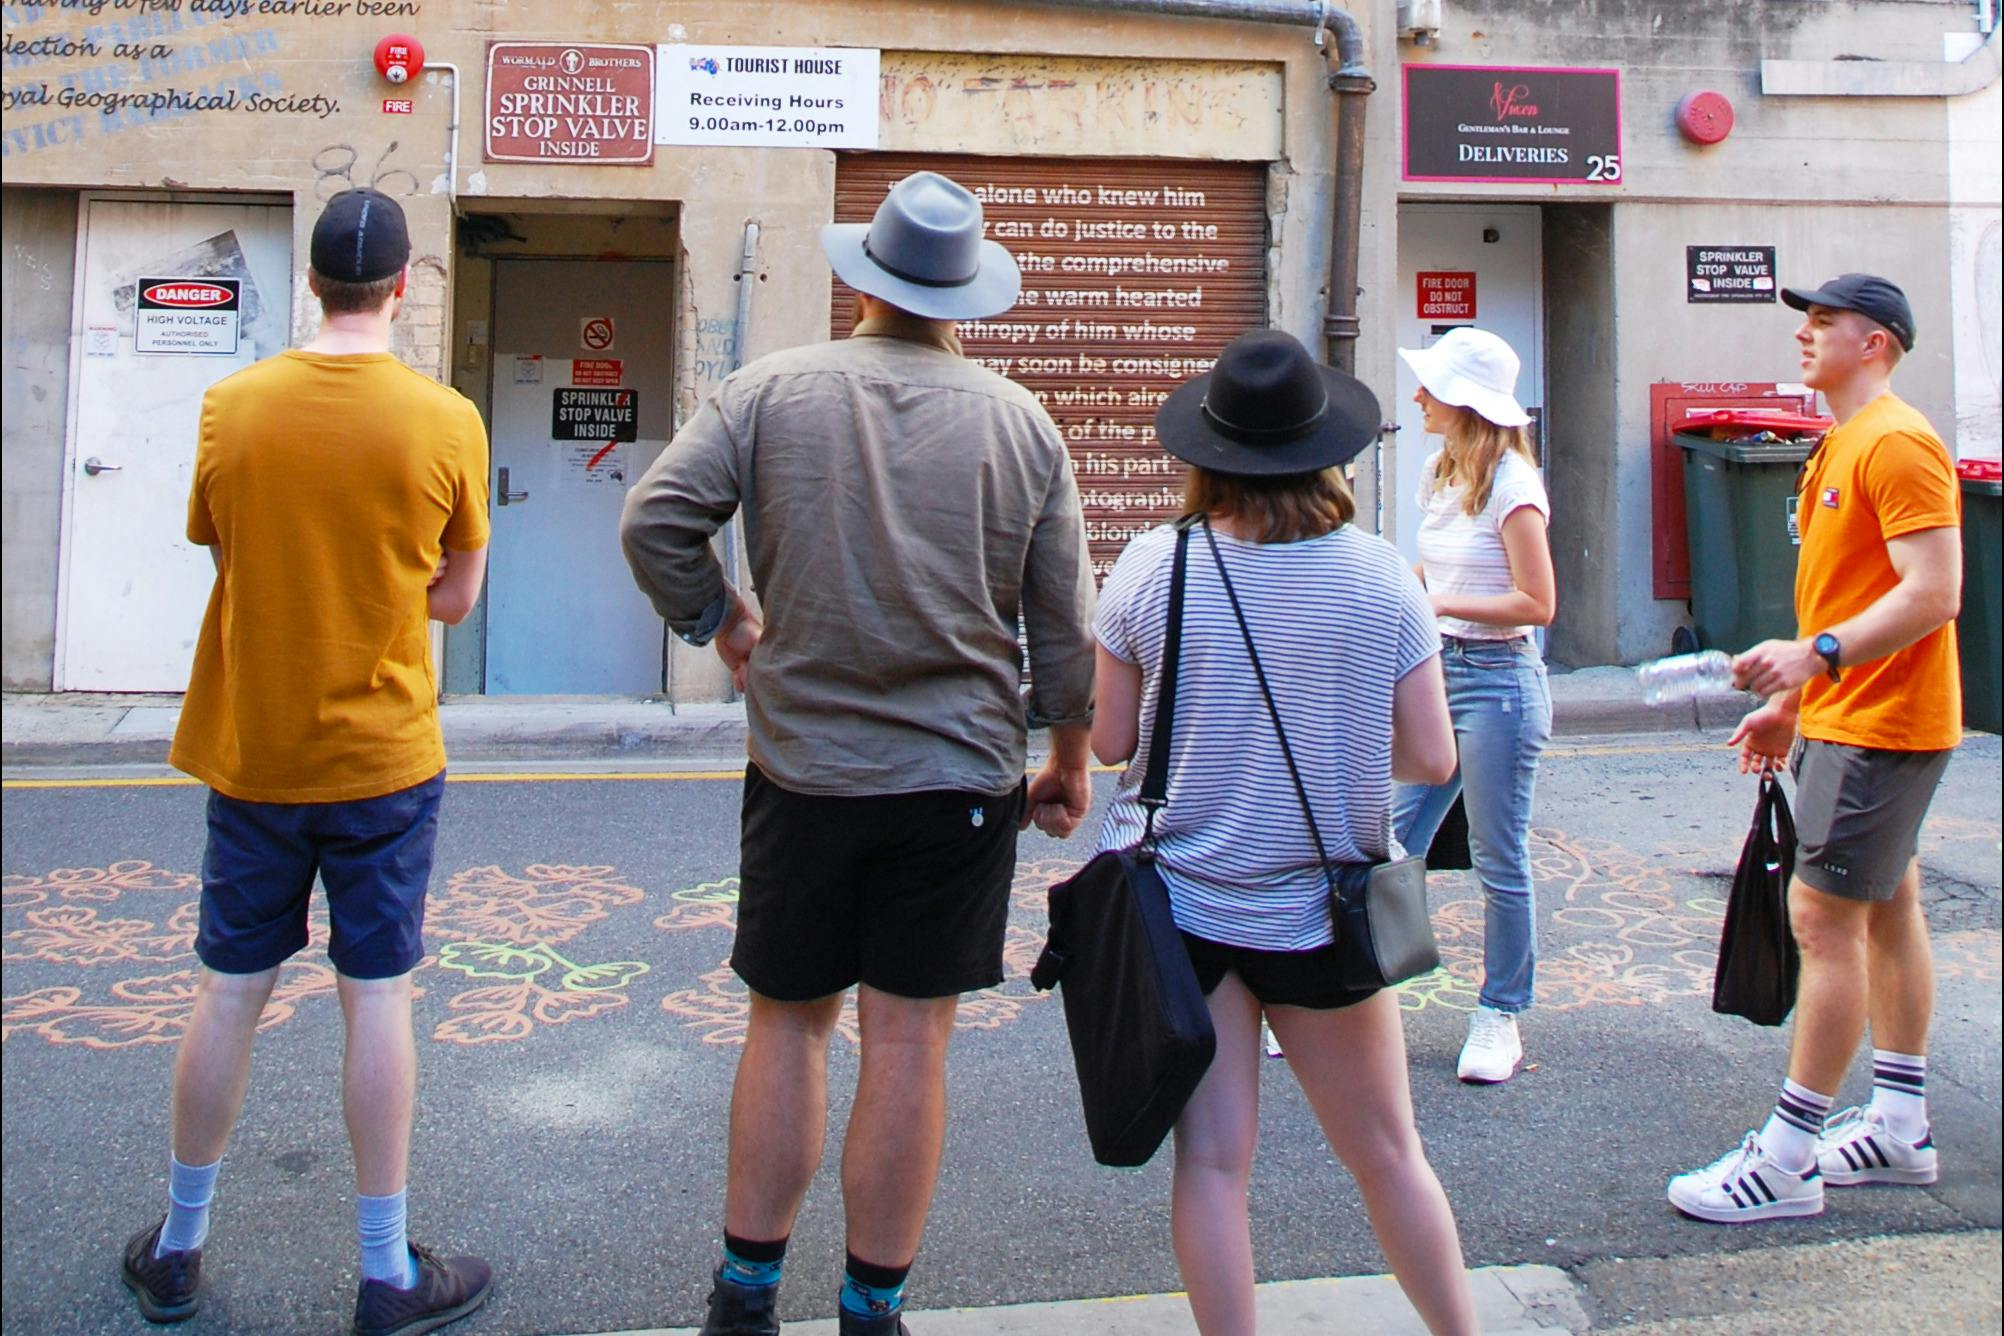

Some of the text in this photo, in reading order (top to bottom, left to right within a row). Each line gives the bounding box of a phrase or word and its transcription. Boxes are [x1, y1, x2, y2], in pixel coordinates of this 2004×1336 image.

[258, 0, 351, 16] earlier
[356, 0, 421, 16] been
[113, 43, 146, 60] as
[150, 43, 174, 60] a
[502, 55, 642, 68] WORMALD BROTHERS
[726, 57, 843, 76] TOURIST HOUSE
[523, 76, 616, 93] GRINNELL
[57, 87, 241, 116] Geographical
[245, 93, 341, 119] Society.
[385, 100, 411, 113] FIRE
[500, 93, 640, 117] SPRINKLER
[690, 92, 844, 110] Receiving Hours
[491, 116, 648, 140] STOP VALVE
[689, 116, 845, 136] 9.00am-12.00pm
[540, 140, 600, 157] INSIDE
[1459, 143, 1569, 163] DELIVERIES
[1586, 155, 1621, 181] 25
[975, 183, 1206, 206] alone who knew him
[994, 221, 1034, 237] can
[1040, 217, 1069, 238] do
[1074, 219, 1147, 241] justice
[1151, 221, 1176, 239] to
[1181, 221, 1218, 240] the
[1016, 251, 1230, 276] the comprehensive
[1699, 251, 1764, 263] SPRINKLER
[1696, 264, 1769, 275] STOP VALVE
[1422, 278, 1469, 288] FIRE DOOR
[1713, 277, 1752, 289] INSIDE
[156, 289, 222, 302] DANGER
[1044, 290, 1109, 306] warm
[1115, 285, 1202, 307] hearted
[1429, 291, 1463, 302] DO NOT
[1423, 303, 1470, 314] OBSTRUCT
[146, 315, 228, 326] HIGH VOLTAGE
[1045, 318, 1071, 339] of
[1074, 320, 1117, 340] him
[1121, 320, 1197, 341] whose
[152, 339, 197, 347] PERSONNEL
[973, 358, 1012, 377] ay
[1018, 357, 1073, 373] soon
[1079, 352, 1107, 374] be
[1054, 386, 1122, 406] which
[1127, 386, 1169, 406] alre
[559, 407, 632, 423] STOP VALVE
[574, 424, 616, 437] INSIDE
[1067, 418, 1095, 440] of
[1099, 419, 1136, 440] the
[1086, 451, 1119, 475] his
